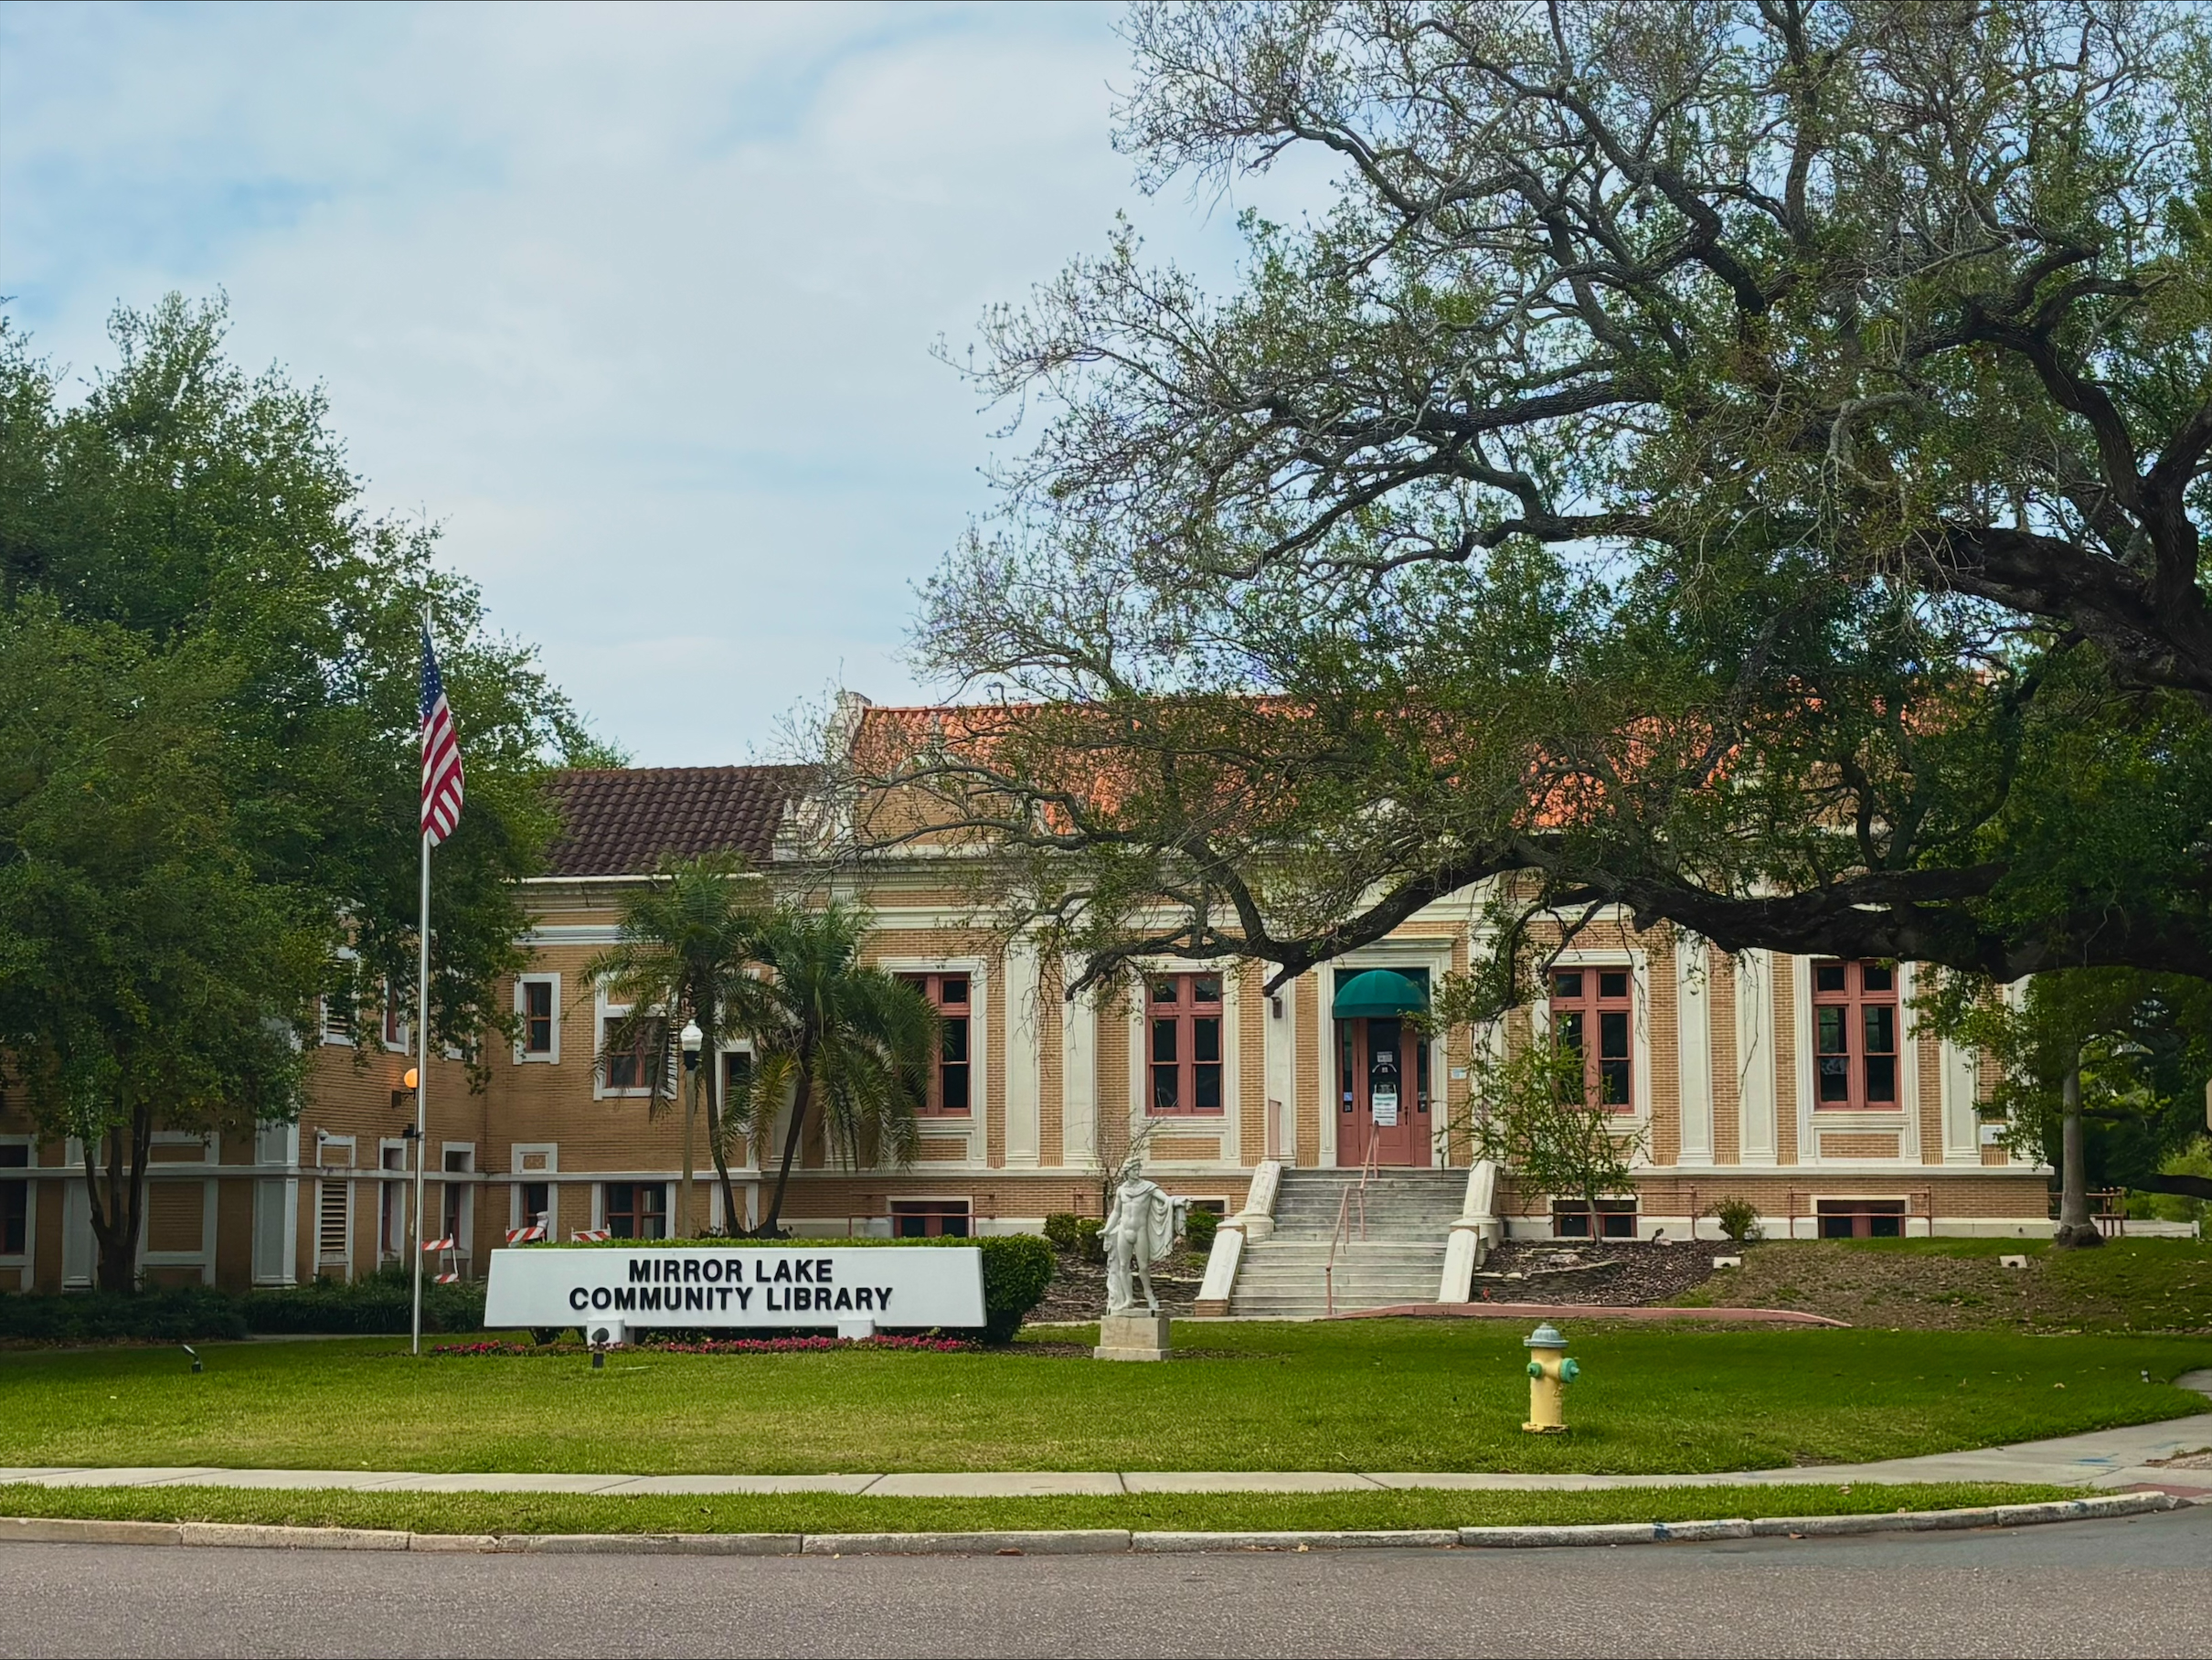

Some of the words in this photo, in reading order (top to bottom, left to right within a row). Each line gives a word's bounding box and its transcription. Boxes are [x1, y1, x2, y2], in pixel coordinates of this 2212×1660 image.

[629, 1259, 743, 1283] MIRROR
[755, 1259, 834, 1283] LAKE
[569, 1286, 754, 1311] COMMUNITY
[766, 1286, 893, 1311] LIBRARY
